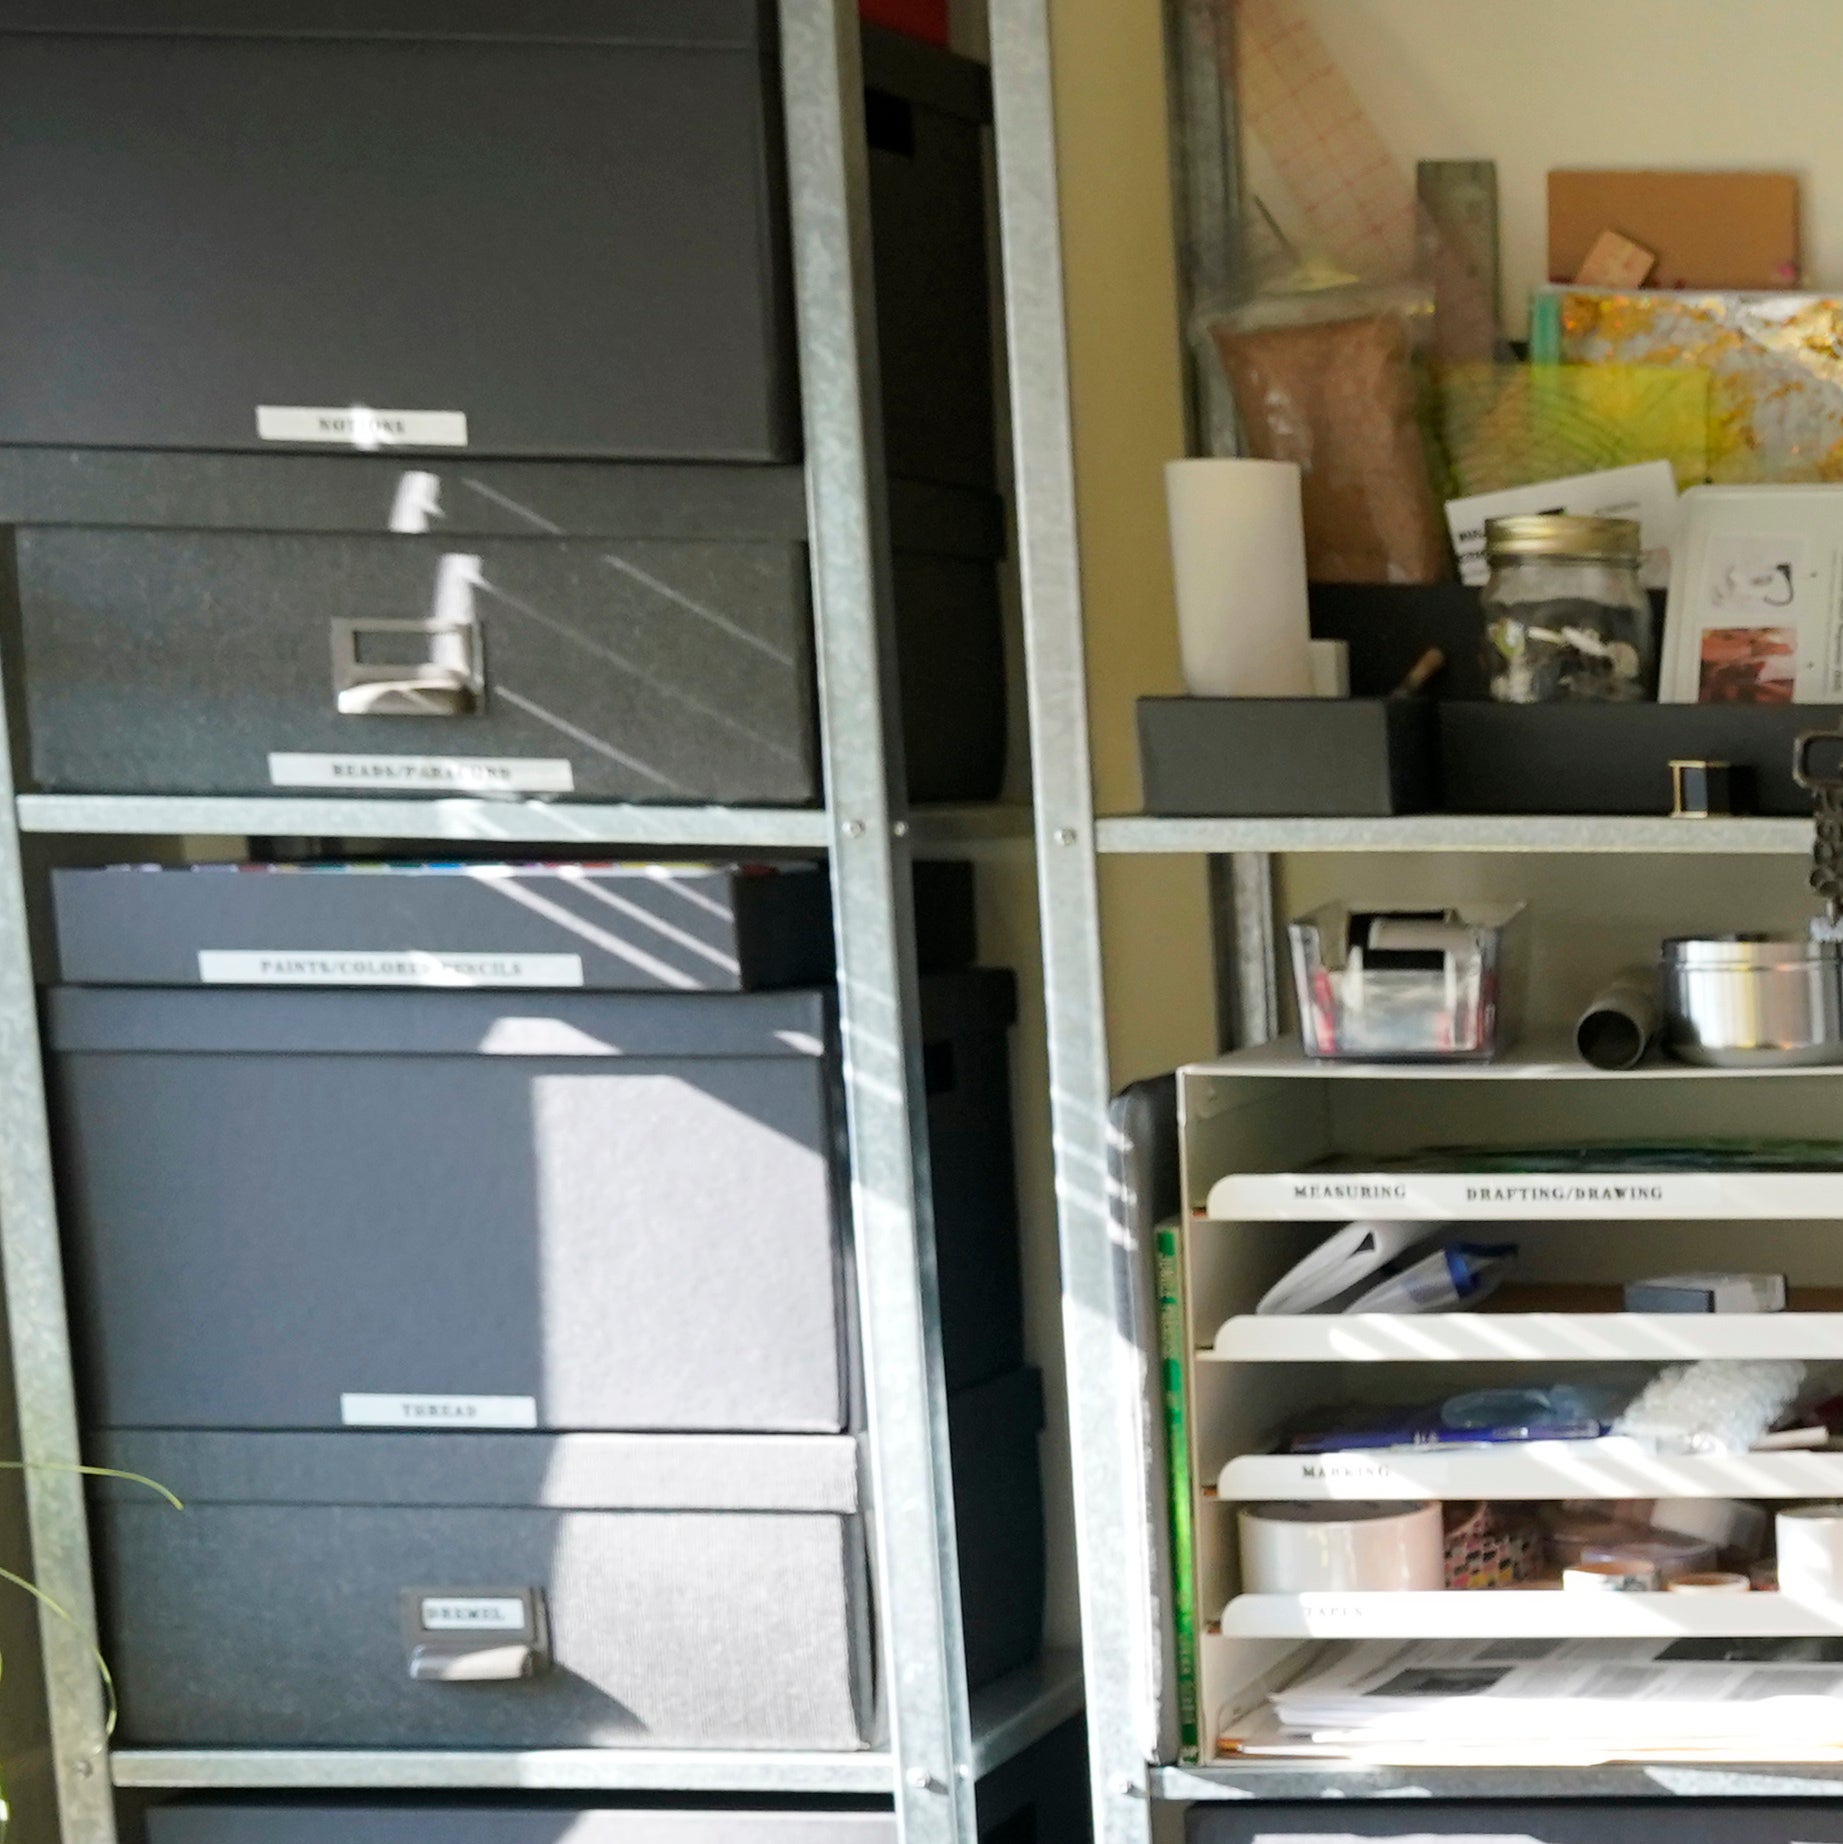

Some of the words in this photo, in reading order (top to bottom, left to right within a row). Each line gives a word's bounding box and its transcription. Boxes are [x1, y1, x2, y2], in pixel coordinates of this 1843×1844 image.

[318, 416, 406, 434] NOTONS
[1294, 1184, 1407, 1199] MEASURING
[1465, 1185, 1664, 1202] DRAFTING/DRAWING
[402, 1404, 478, 1419] THREAD
